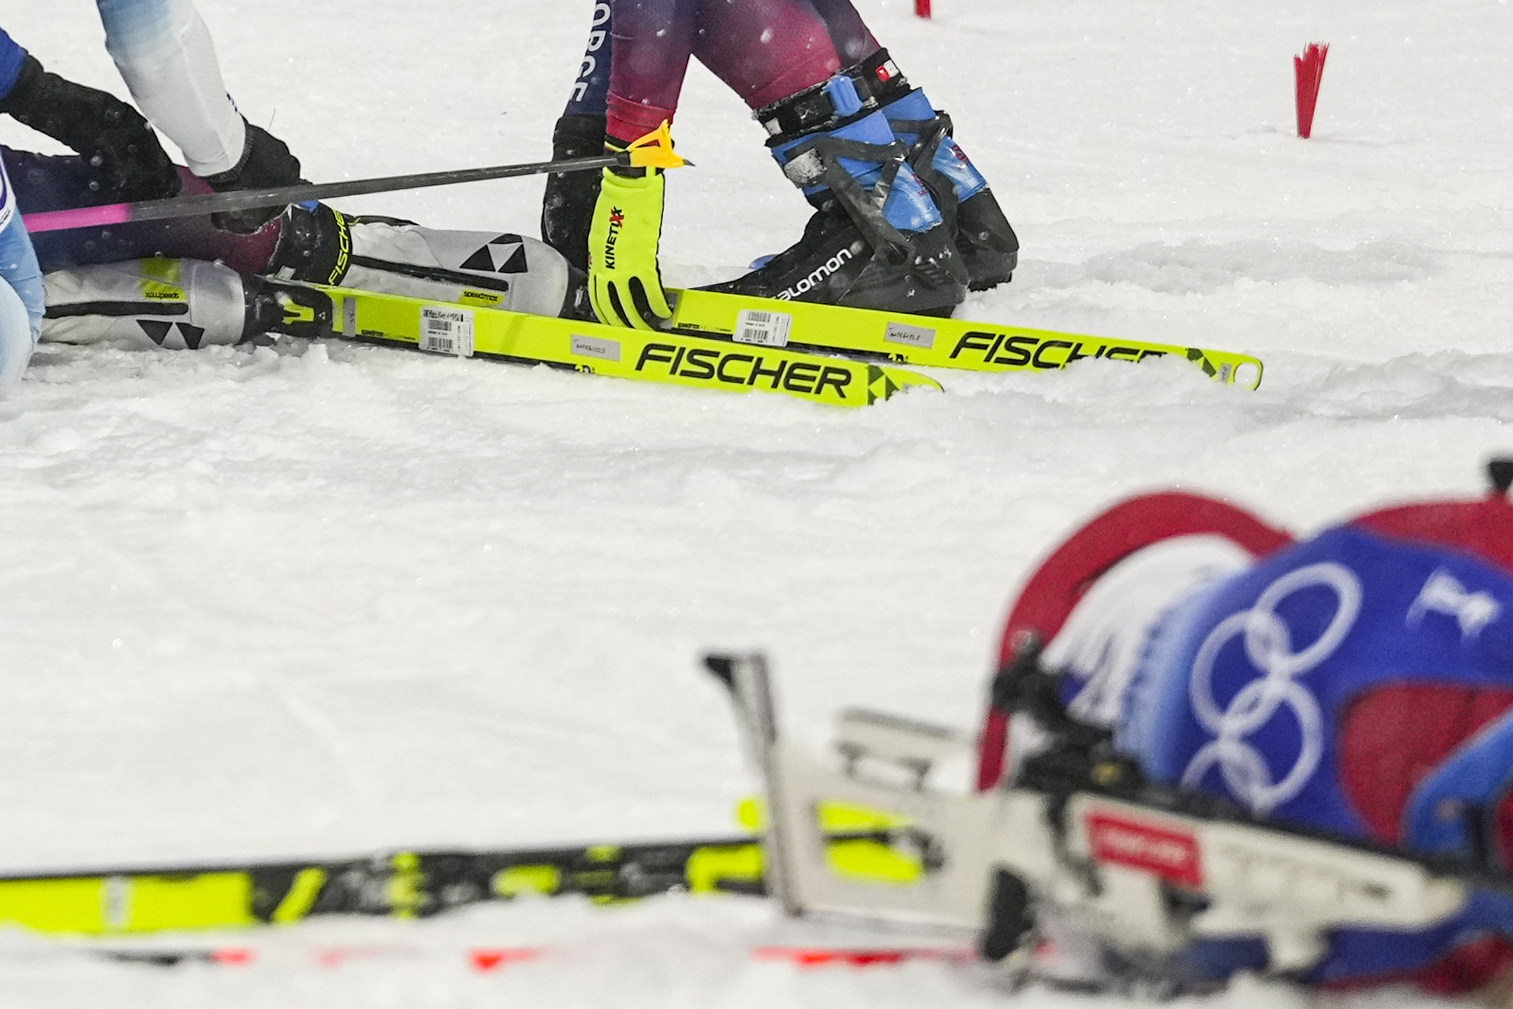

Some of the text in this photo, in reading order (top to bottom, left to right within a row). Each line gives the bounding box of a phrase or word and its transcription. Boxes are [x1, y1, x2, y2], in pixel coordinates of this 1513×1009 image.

[327, 208, 350, 286] FISCHE
[772, 247, 852, 302] alomon
[634, 342, 852, 398] FISCHER
[948, 331, 1168, 371] FISCHE
